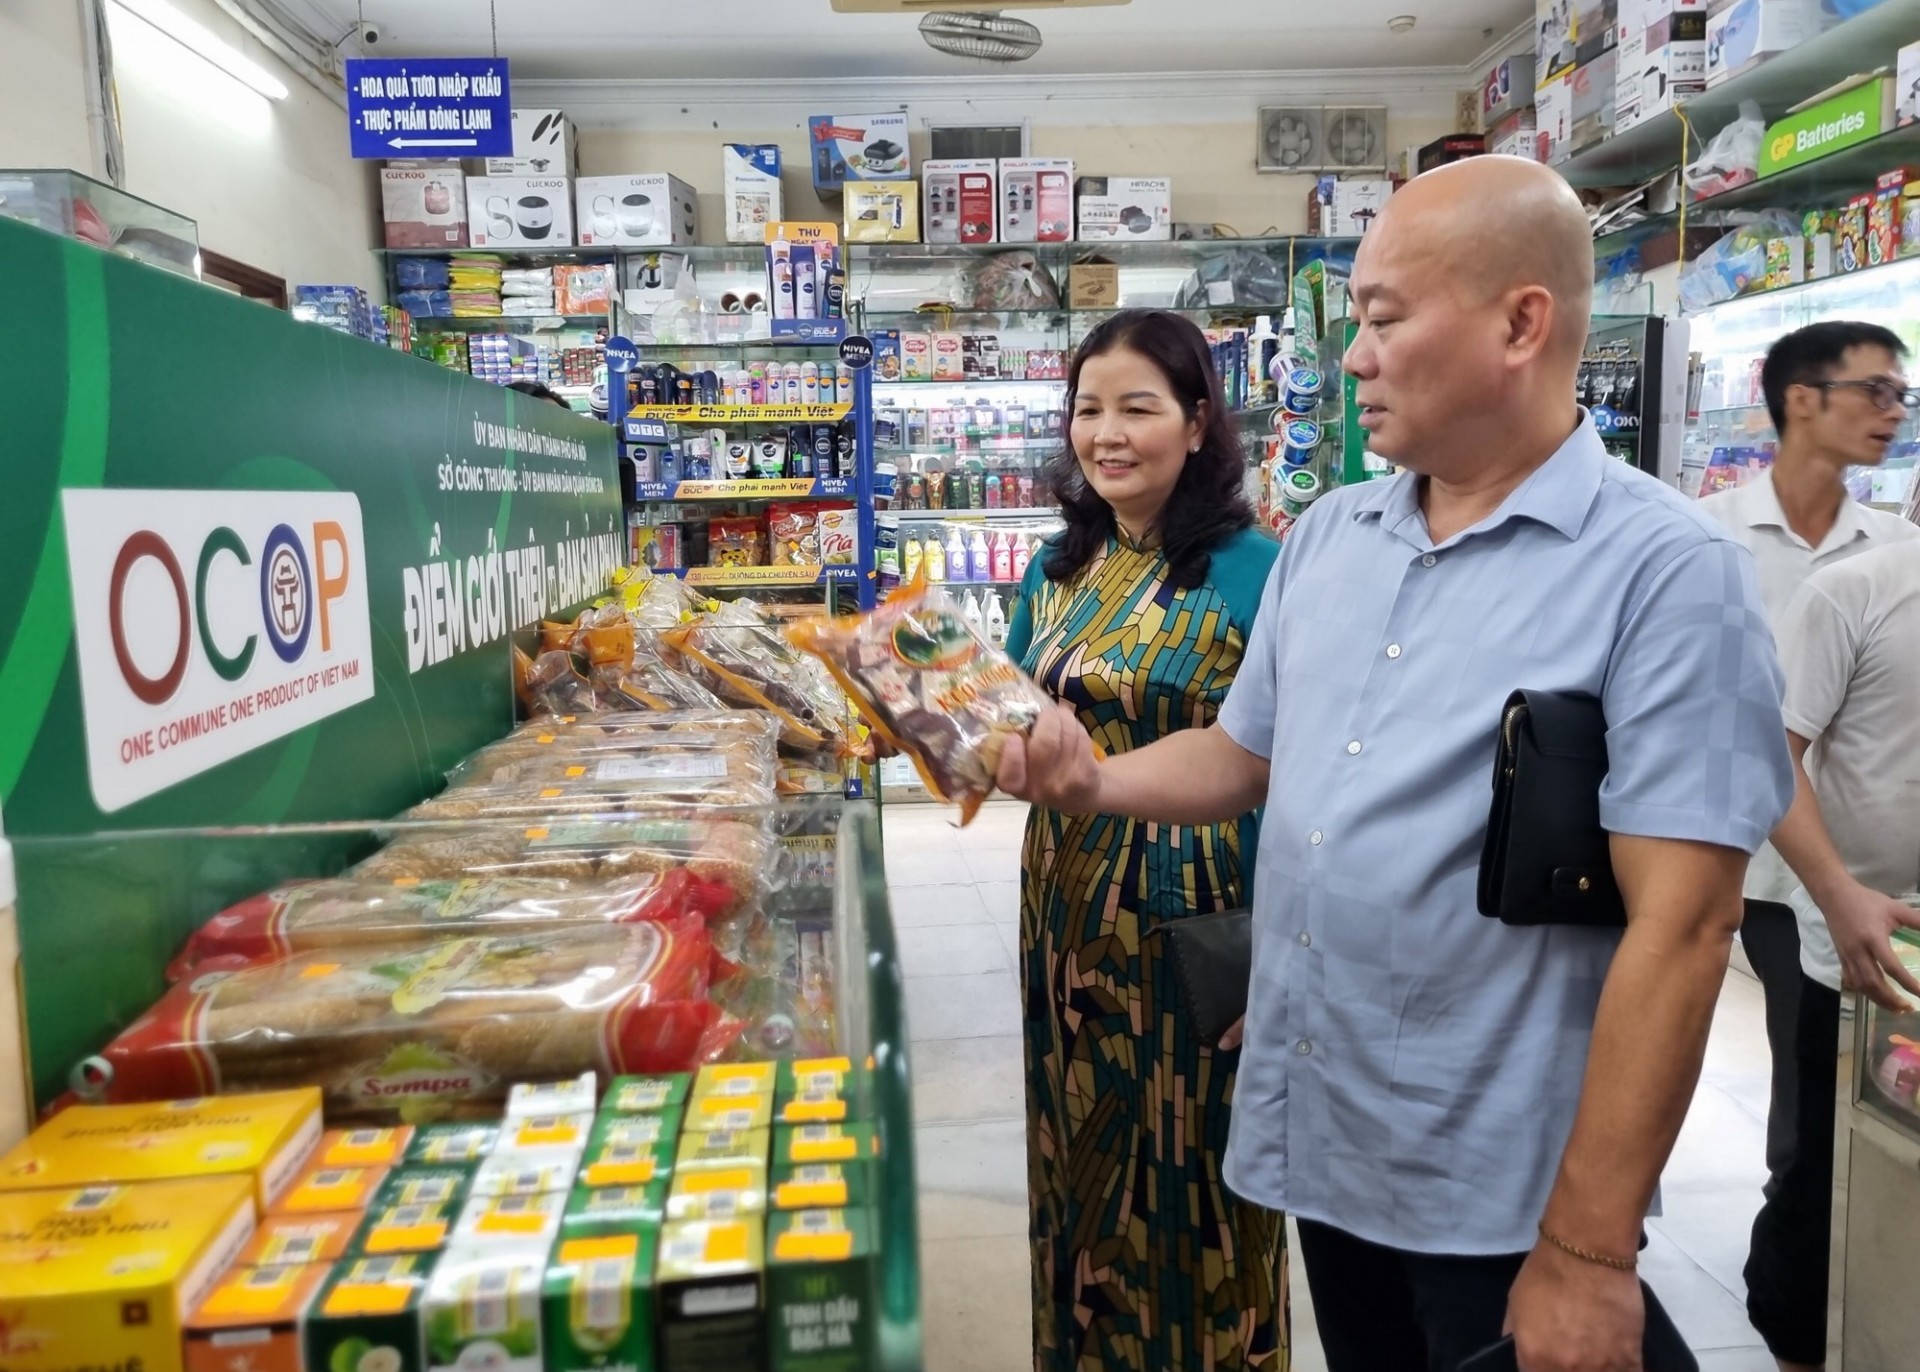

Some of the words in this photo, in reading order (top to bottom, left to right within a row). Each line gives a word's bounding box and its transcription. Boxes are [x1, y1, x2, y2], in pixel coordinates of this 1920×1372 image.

[361, 77, 384, 97] HOA
[386, 68, 409, 99] QUẢ
[411, 75, 437, 97] TƯƠI
[439, 72, 468, 101] NHẬP
[472, 68, 501, 97] KHẨU
[363, 108, 391, 135] THỰC
[394, 102, 427, 130] PHẨM
[429, 105, 460, 130] ĐÔNG
[463, 109, 491, 134] LẠNH
[1771, 133, 1795, 162] GP
[1796, 111, 1865, 152] Batteries
[386, 171, 425, 179] CUCKOO
[630, 178, 664, 186] CUCKOO
[607, 350, 635, 359] NIVEA
[843, 345, 870, 354] NIVEA
[699, 407, 725, 418] Cho
[730, 407, 759, 419] phái
[765, 407, 801, 418] mạnh
[807, 406, 834, 418] Việt
[474, 411, 486, 446] ỦY
[488, 423, 506, 449] BAN
[507, 424, 528, 452] NHÂN
[528, 427, 542, 454] DÂN
[630, 424, 663, 436] VTC
[438, 454, 453, 490] SỞ
[456, 458, 483, 491] CÔNG
[484, 465, 517, 492] THƯƠNG
[533, 471, 545, 492] BAN
[641, 482, 667, 490] NIVEA
[718, 483, 736, 492] Cho
[739, 483, 758, 494] phái
[762, 483, 786, 493] mạnh
[790, 482, 808, 493] Việt
[826, 569, 857, 578] NIVEA
[403, 521, 466, 674] ĐIỂM
[467, 528, 507, 648] GIỚI
[505, 527, 546, 637] THIỆU
[557, 520, 581, 610] BÁN
[580, 512, 600, 601] SẢN
[109, 521, 349, 705] OCOP
[120, 730, 154, 765] ONE
[158, 706, 227, 750] COMMUNE
[230, 695, 255, 723] ONE
[256, 677, 305, 713] PRODUCT
[307, 673, 319, 694] OF
[322, 666, 341, 689] VIET
[342, 659, 359, 679] NAM
[362, 1078, 470, 1096] Sompa
